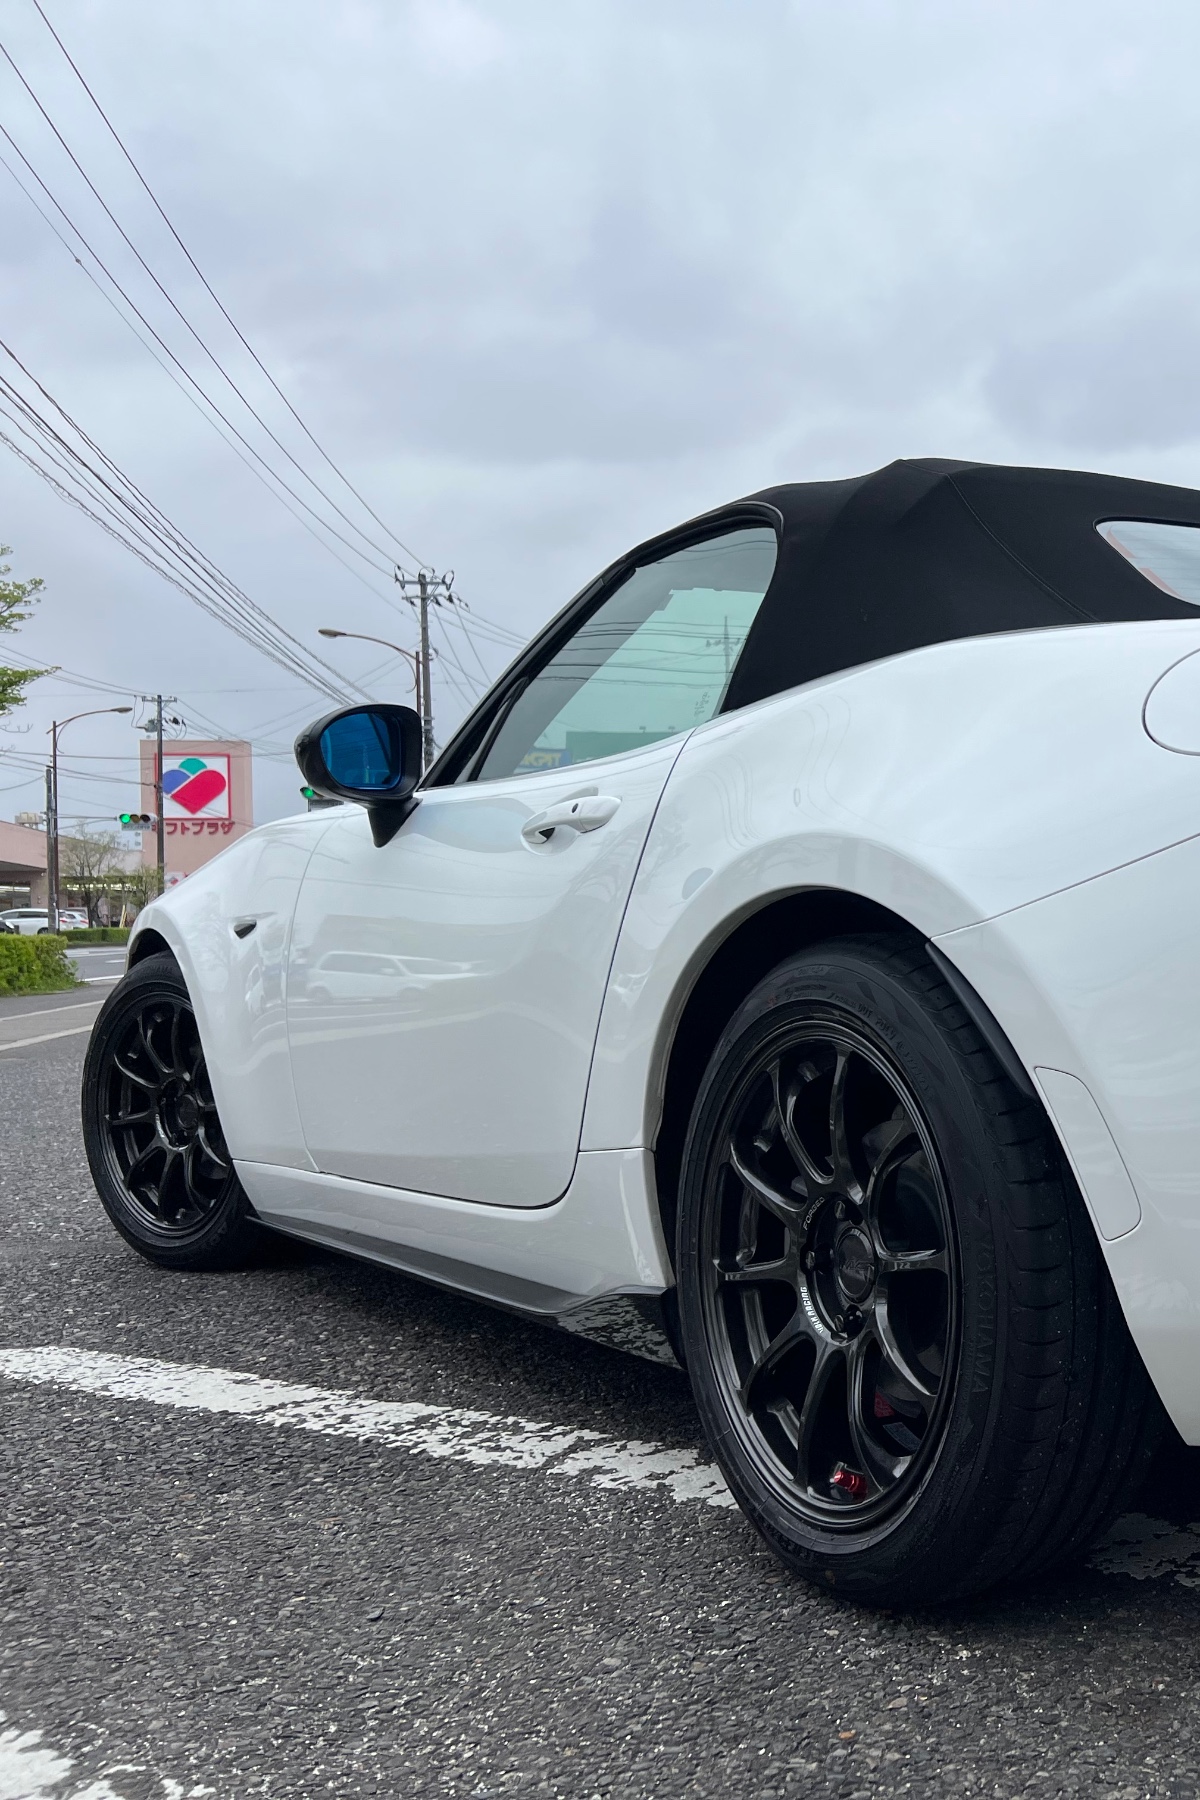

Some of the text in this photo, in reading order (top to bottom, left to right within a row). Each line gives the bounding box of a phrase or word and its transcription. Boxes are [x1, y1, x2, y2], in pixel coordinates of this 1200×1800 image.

[802, 1196, 825, 1231] FORGED
[800, 1286, 816, 1316] RACING
[966, 1240, 990, 1393] YOKOHAMA
